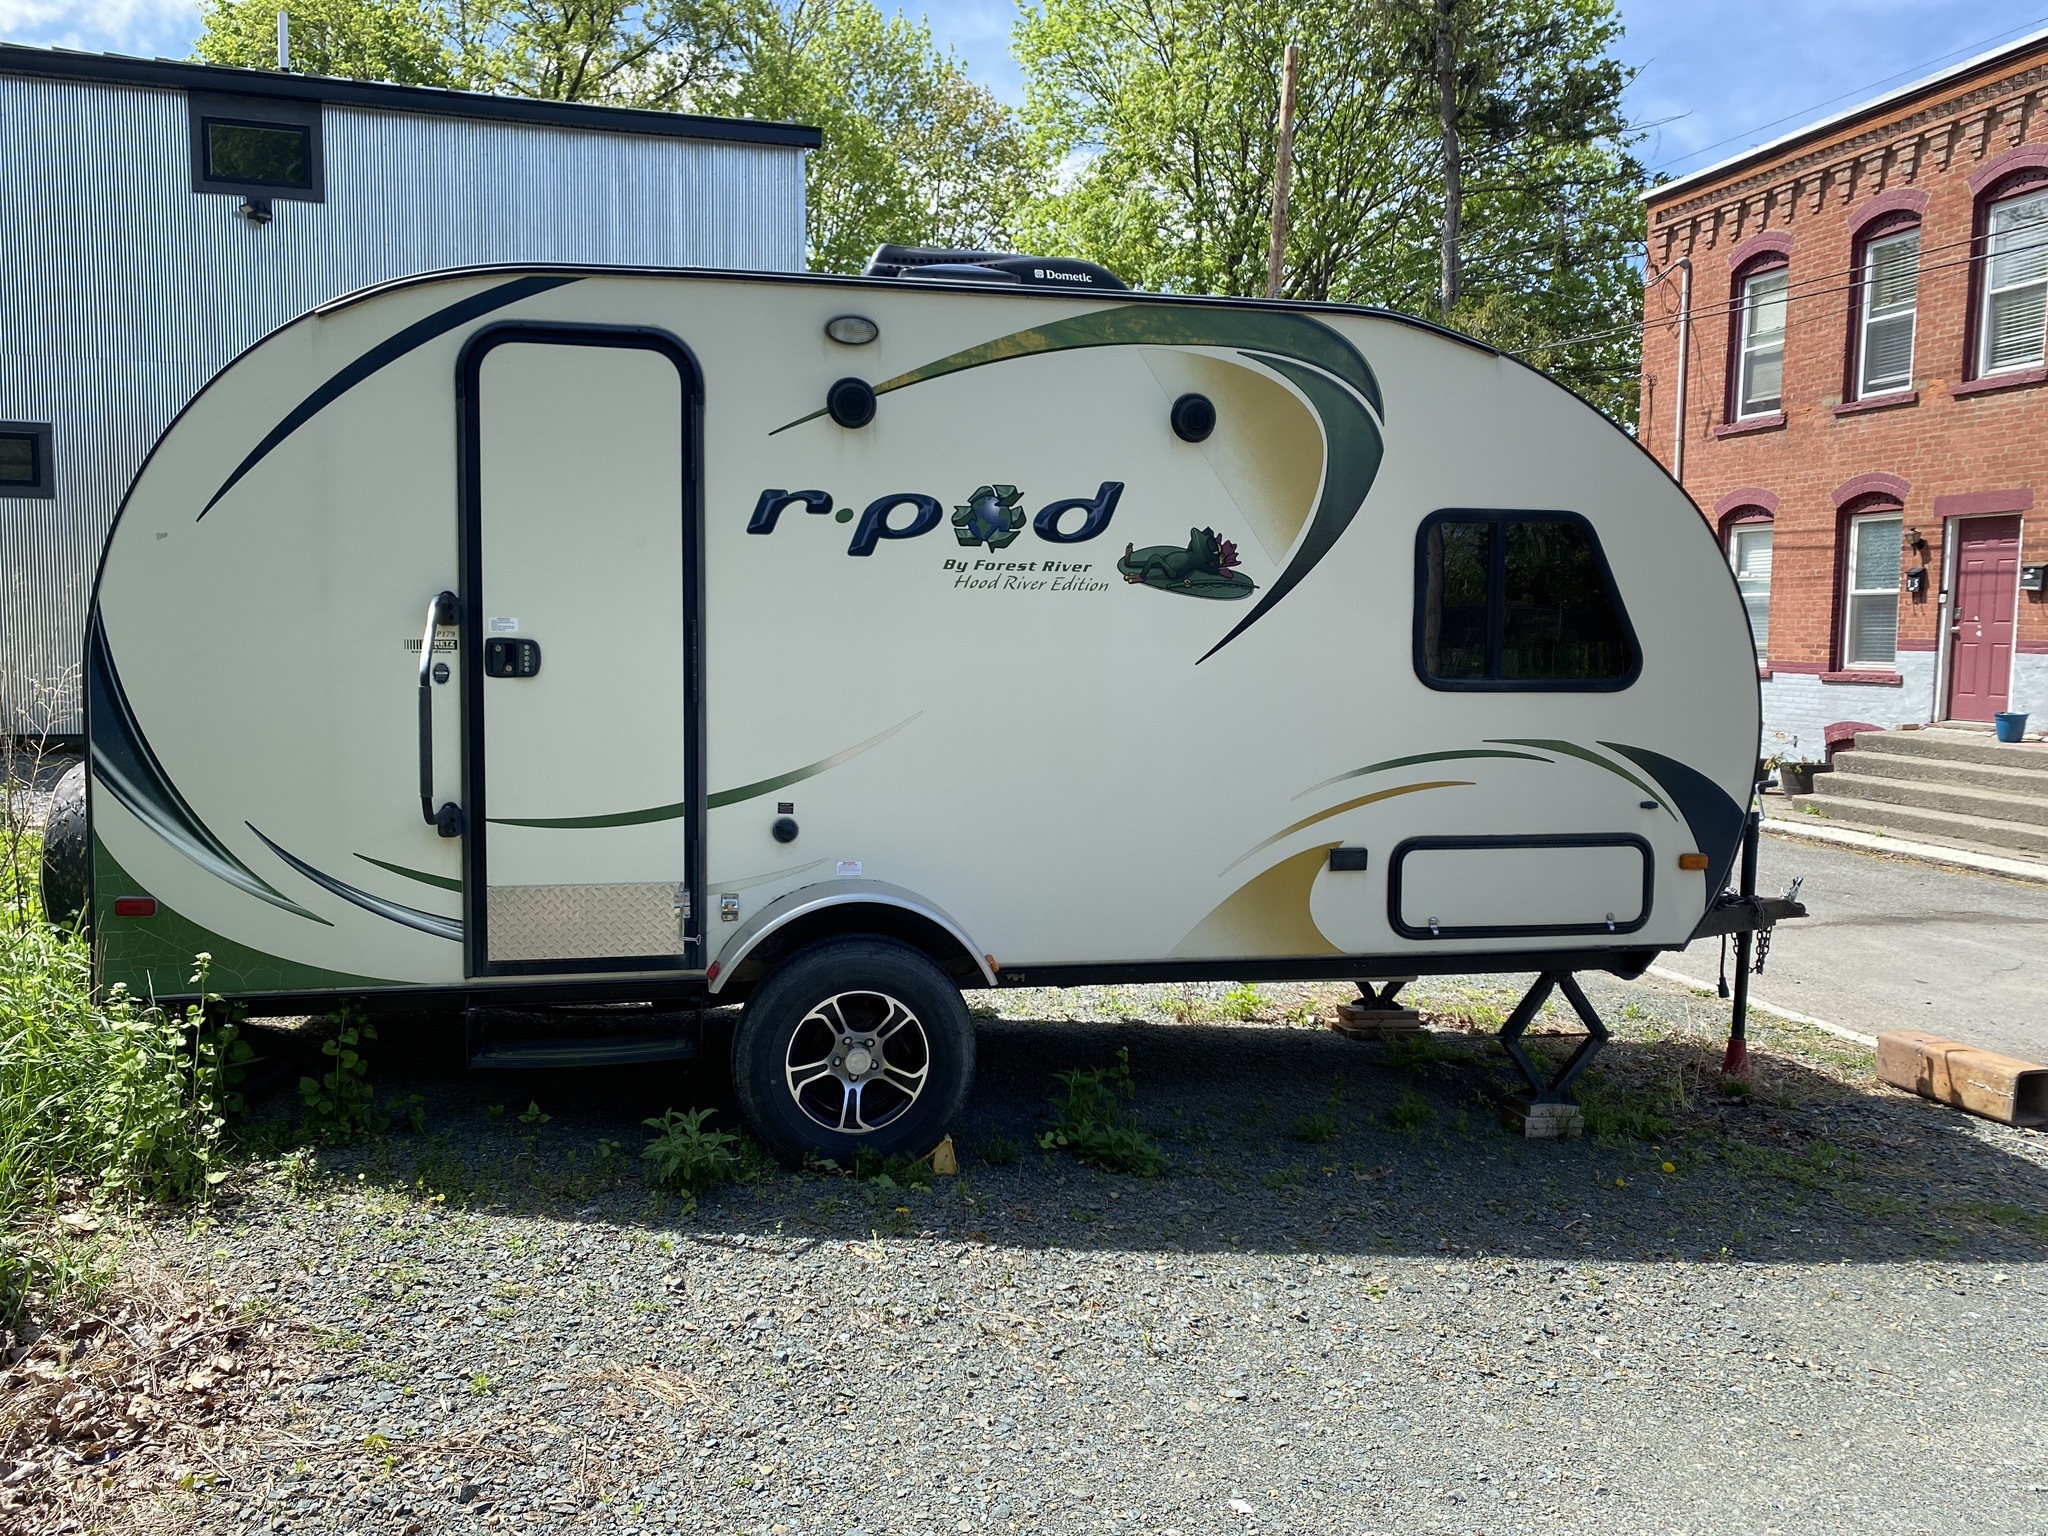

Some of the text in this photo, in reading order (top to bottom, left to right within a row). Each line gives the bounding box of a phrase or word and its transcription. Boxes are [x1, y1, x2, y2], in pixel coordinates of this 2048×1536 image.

[1046, 269, 1092, 283] Dometic
[943, 558, 1092, 573] By Forest River
[954, 573, 1109, 592] Hood River Edition
